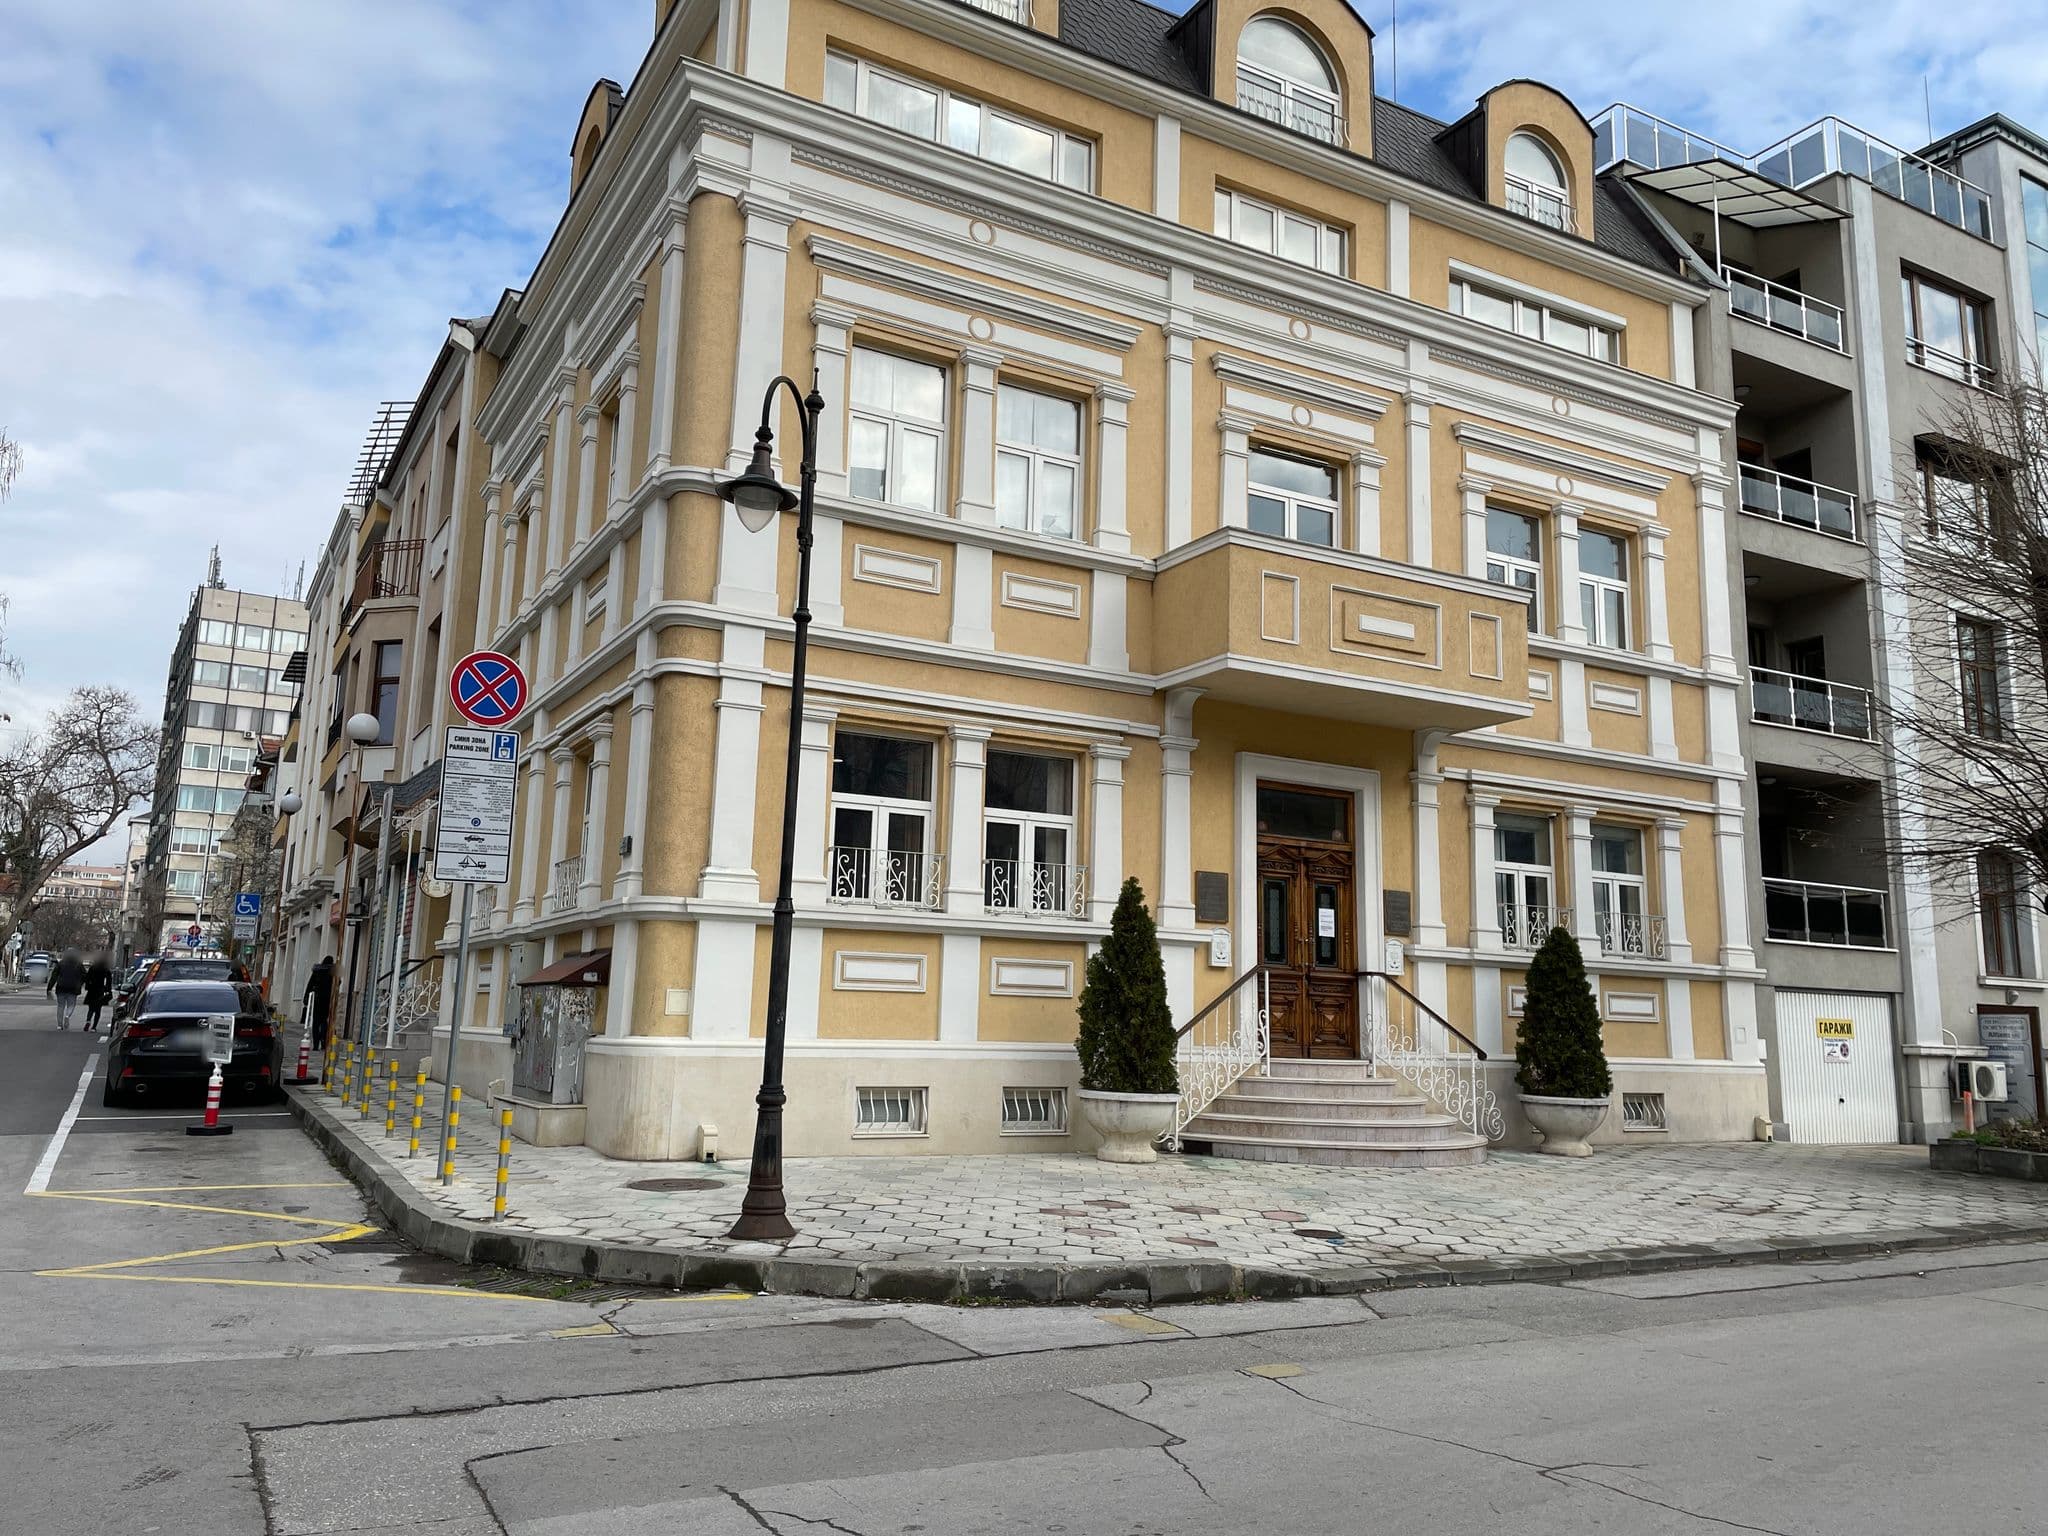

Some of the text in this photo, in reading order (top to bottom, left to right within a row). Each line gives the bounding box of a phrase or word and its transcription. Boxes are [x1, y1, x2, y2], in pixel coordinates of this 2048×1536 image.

[454, 735, 470, 743] СИНЯ
[501, 735, 510, 747] P
[449, 743, 474, 752] PARKING
[1819, 1021, 1852, 1035] ГАРАЖИ
